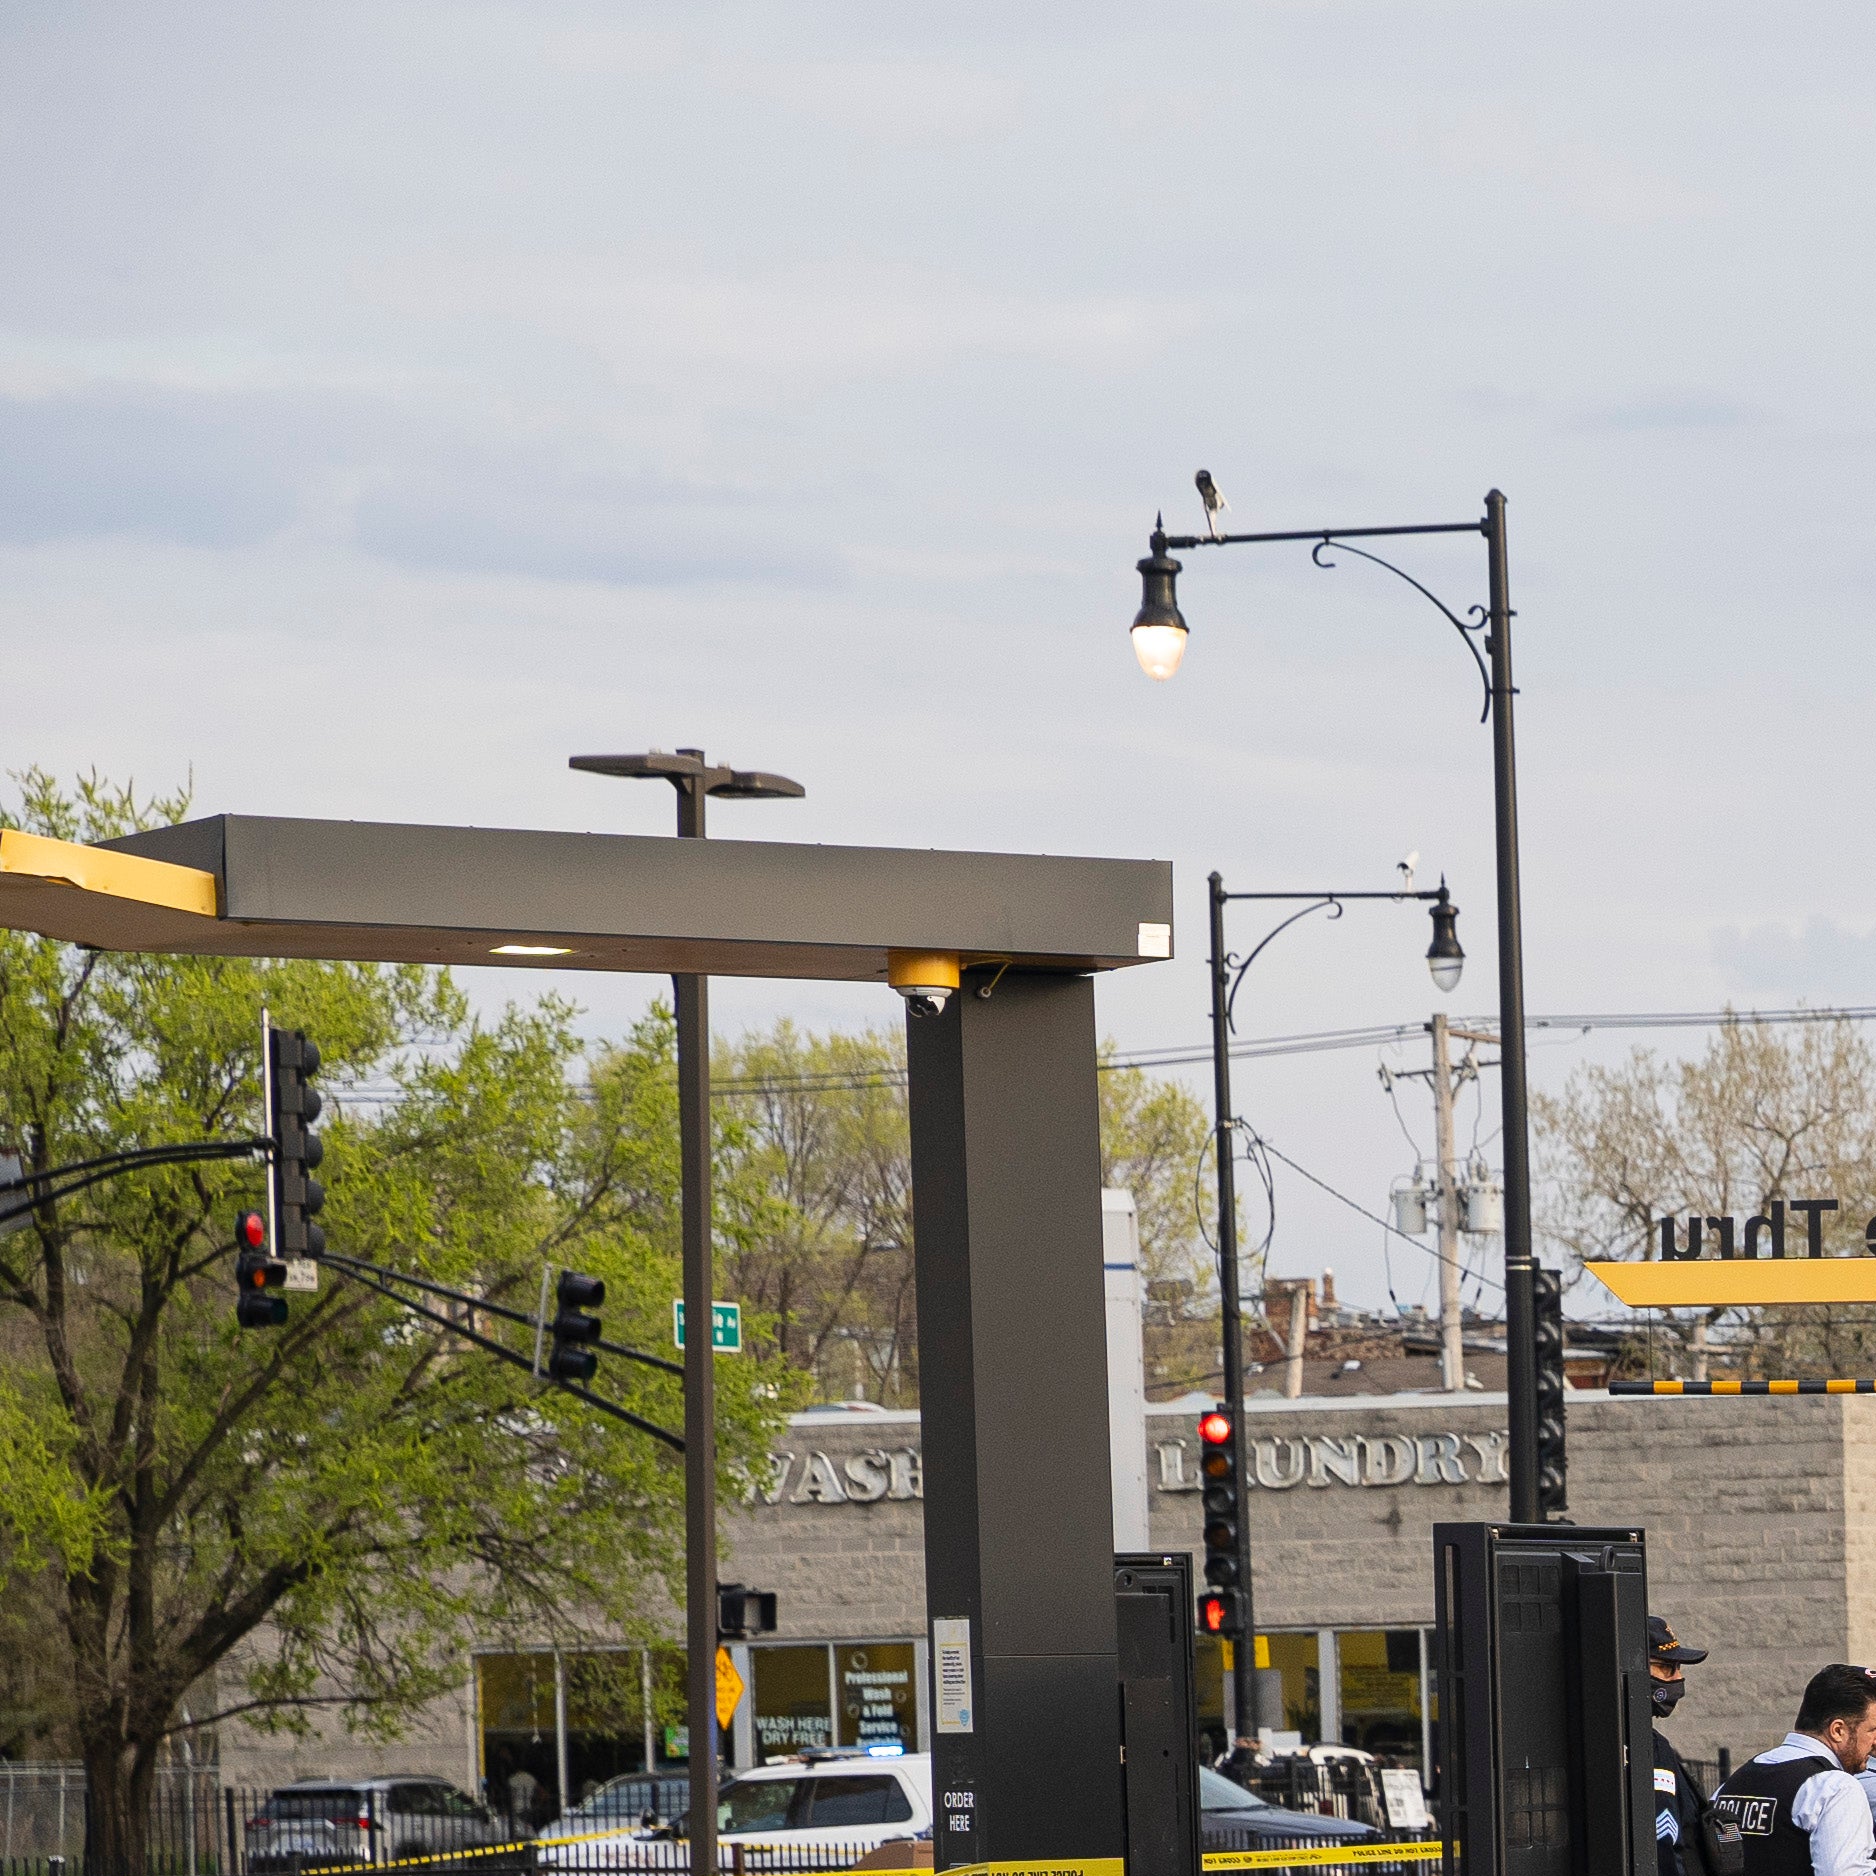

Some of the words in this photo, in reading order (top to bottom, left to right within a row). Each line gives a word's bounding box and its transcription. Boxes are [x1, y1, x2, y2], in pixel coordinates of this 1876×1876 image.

[1155, 1429, 1509, 1492] LUNDRY
[845, 1669, 908, 1685] Professional
[862, 1686, 892, 1701] Wash
[858, 1720, 898, 1735] Service
[944, 1792, 975, 1808] ORDER
[949, 1815, 970, 1832] HERE
